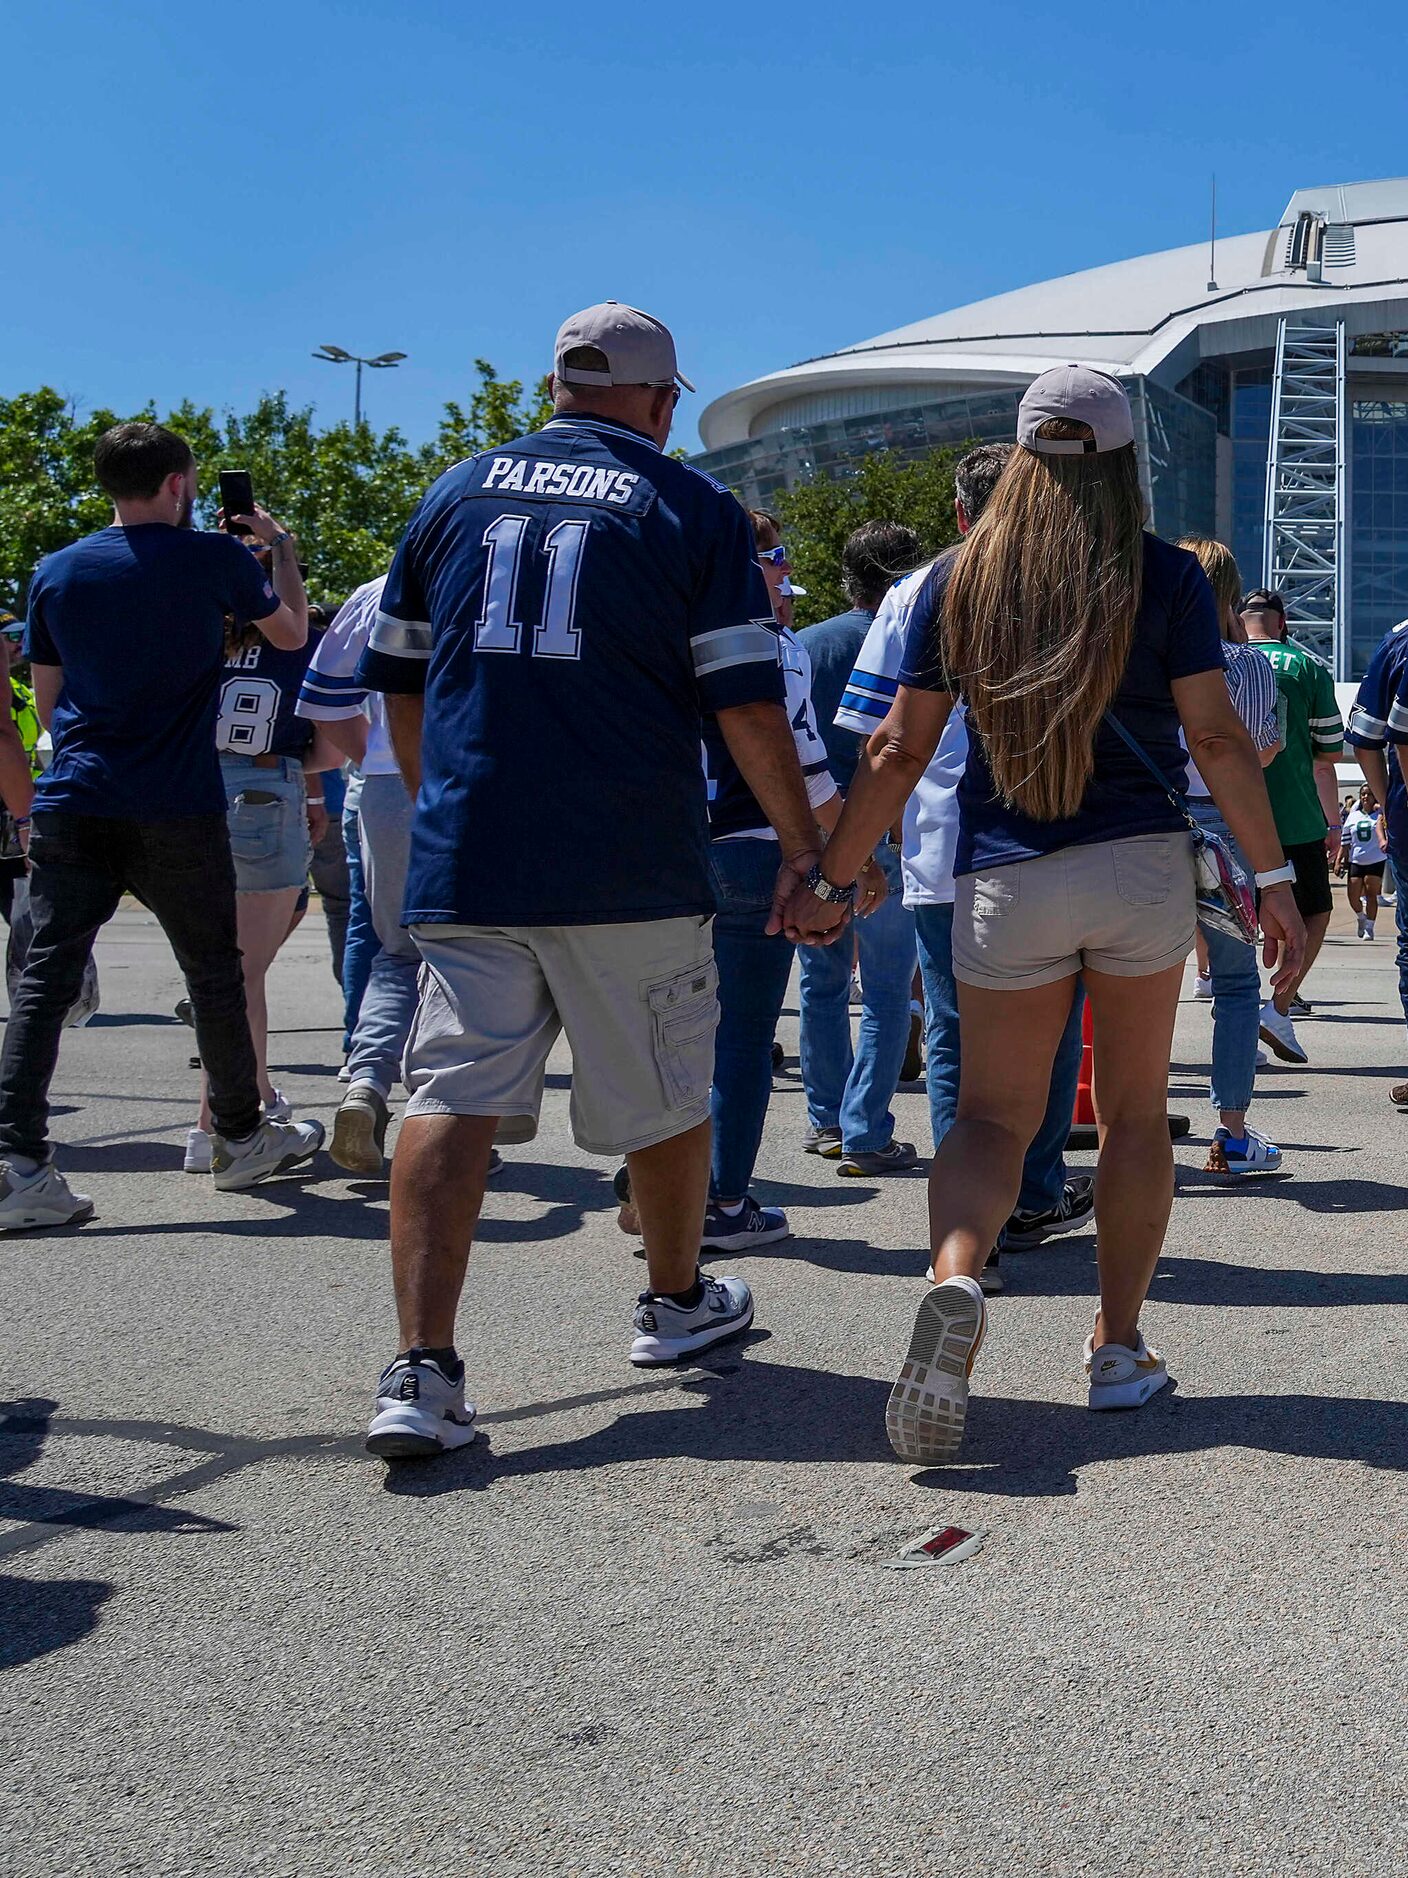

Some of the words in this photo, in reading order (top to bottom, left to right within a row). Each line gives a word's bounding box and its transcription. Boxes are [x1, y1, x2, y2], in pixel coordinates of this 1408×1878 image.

[482, 457, 640, 504] PARSONS
[473, 514, 591, 660] 11
[224, 645, 262, 669] MB
[216, 676, 282, 756] 8
